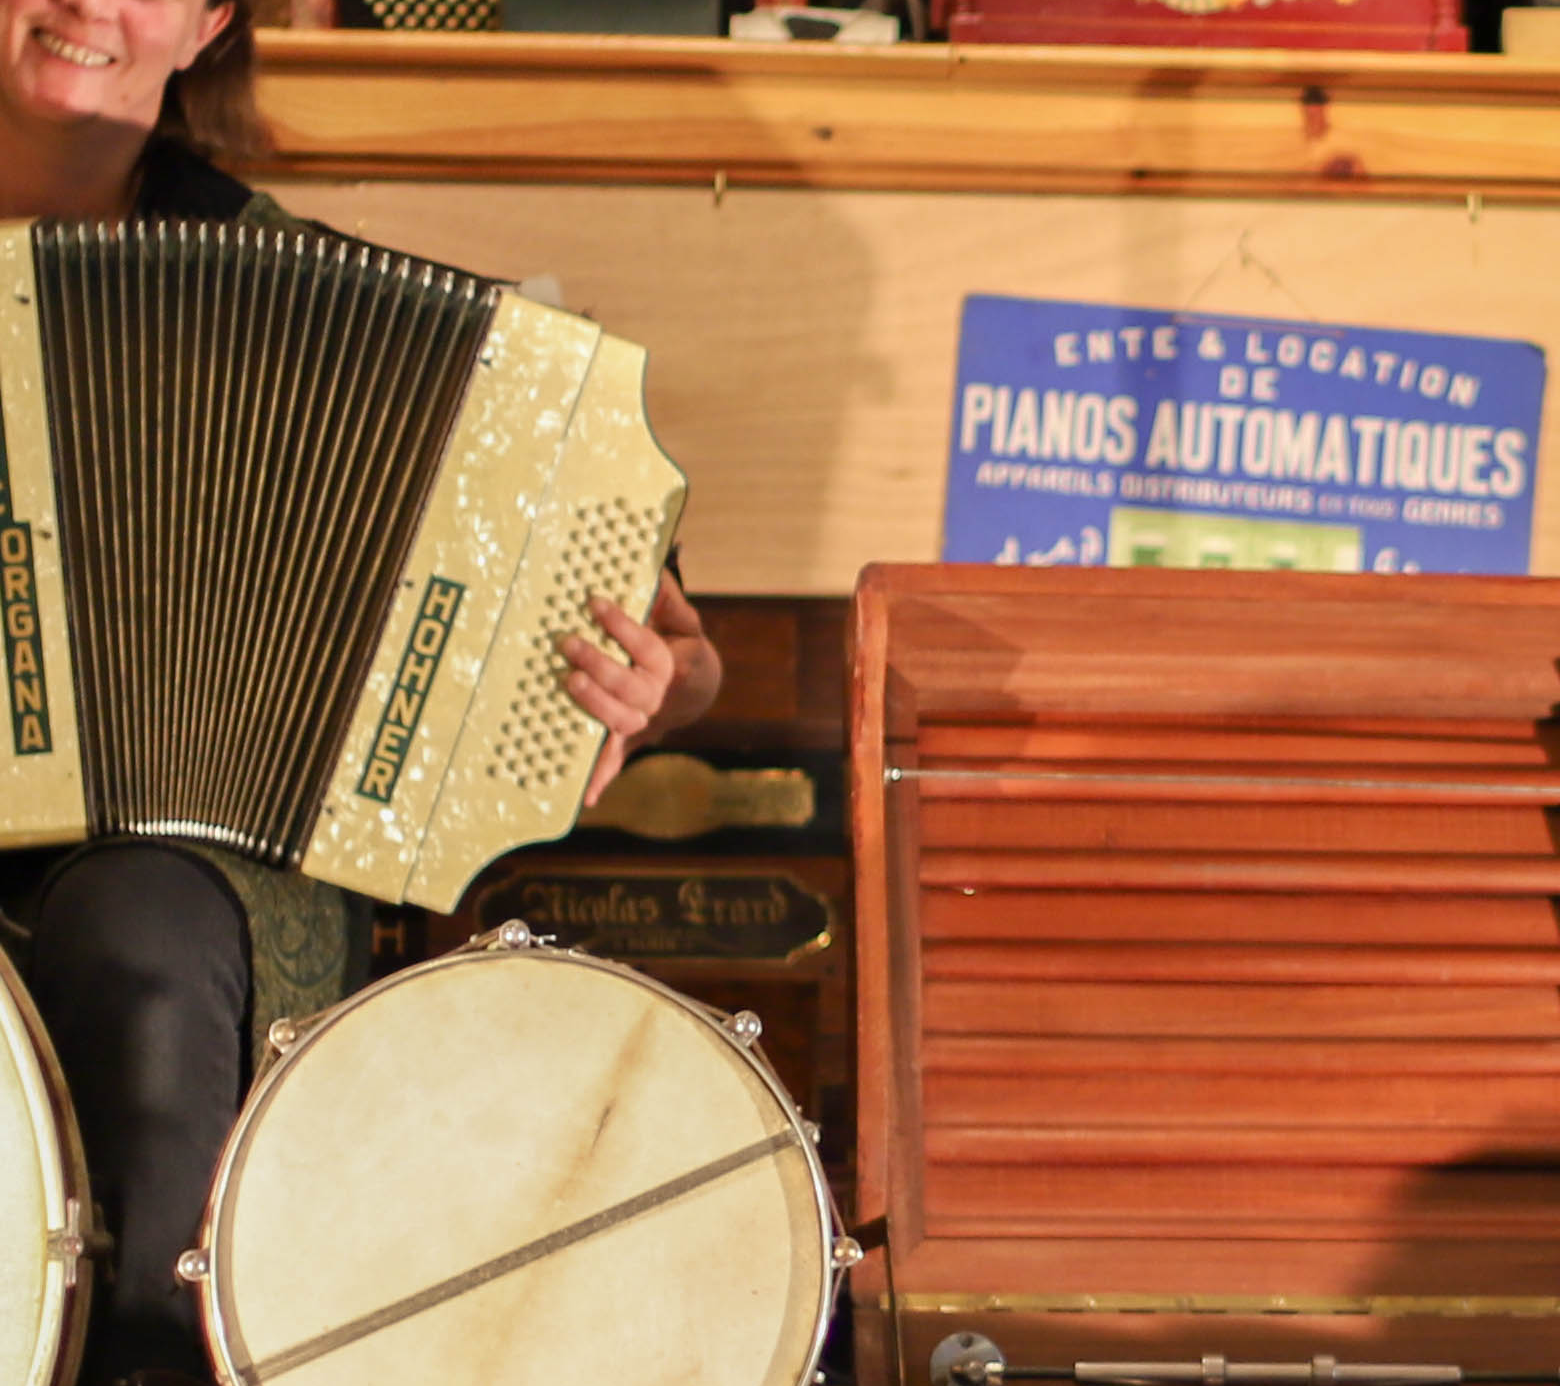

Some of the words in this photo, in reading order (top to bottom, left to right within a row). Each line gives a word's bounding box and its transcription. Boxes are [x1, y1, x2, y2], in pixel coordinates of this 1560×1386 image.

[1197, 327, 1224, 361] &
[1245, 330, 1481, 408] LOCATION
[1219, 369, 1279, 401] DE
[960, 383, 1136, 465] PIANOS
[1146, 399, 1527, 498] AUTOMATIQUES
[976, 461, 1111, 495] APPAREILS
[1402, 500, 1502, 529] GENRES
[2, 528, 46, 752] ORGANA
[363, 583, 463, 800] HOHNER
[522, 879, 661, 926] Nicolas
